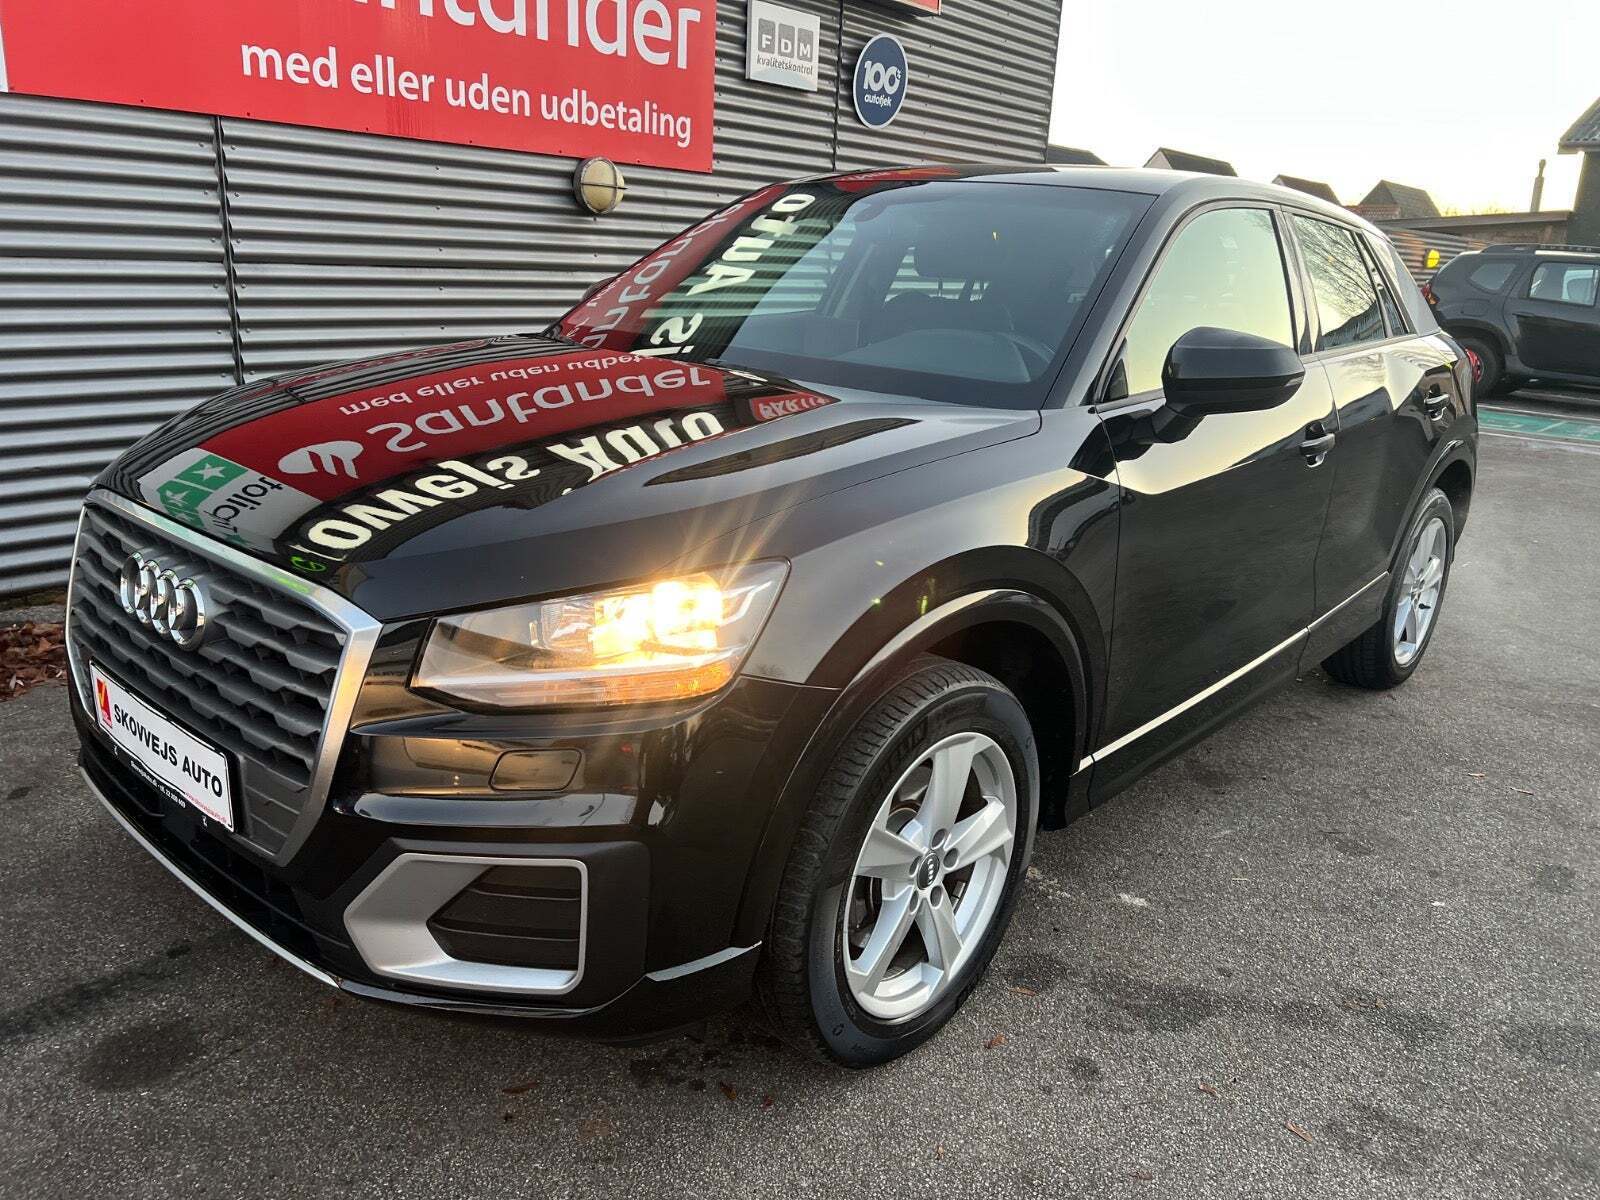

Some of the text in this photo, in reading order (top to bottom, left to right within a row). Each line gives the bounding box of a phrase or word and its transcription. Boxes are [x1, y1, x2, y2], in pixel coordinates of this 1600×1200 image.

[761, 33, 811, 59] FDM
[757, 54, 813, 76] kvalitetskontrol
[240, 43, 693, 148] med eller uden udbetaling
[864, 93, 893, 108] autotjek
[113, 703, 178, 767] SKOVVEJS
[182, 755, 223, 798] AUTO
